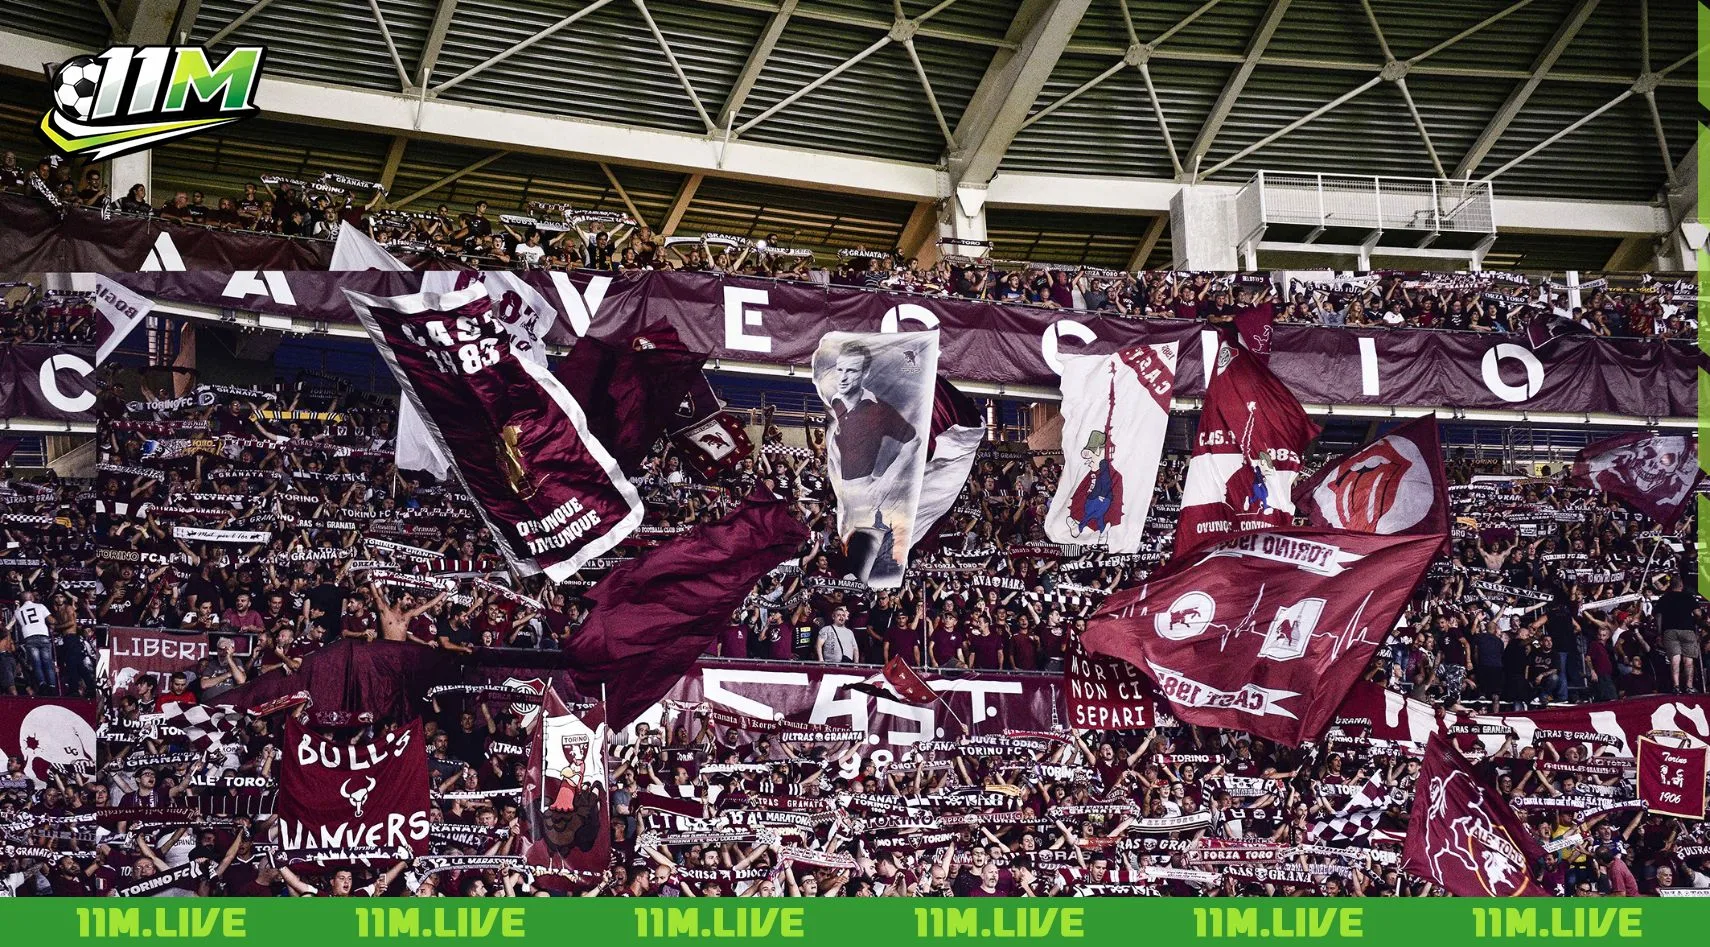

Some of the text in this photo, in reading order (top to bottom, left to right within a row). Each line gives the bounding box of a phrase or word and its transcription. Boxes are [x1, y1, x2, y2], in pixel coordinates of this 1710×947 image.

[311, 182, 345, 194] TORINO
[850, 249, 883, 260] GRANATA
[146, 398, 179, 411] TORINO
[280, 493, 319, 504] TORINO
[341, 508, 376, 518] TORINO
[326, 520, 356, 530] GRANATA
[96, 549, 139, 562] TORINO
[292, 546, 337, 560] GRANATA
[20, 608, 39, 625] 12
[112, 637, 207, 661] LIBERI
[1071, 678, 1142, 701] NON CI
[1076, 704, 1145, 731] SEPARI
[563, 735, 588, 743] TORINO
[783, 731, 862, 742] ULTRAS GRANATA
[298, 730, 411, 771] BULL'S
[959, 746, 1022, 757] TORINO FC
[126, 754, 199, 768] GRANATA
[1170, 754, 1208, 764] TORINO
[1661, 752, 1688, 765] Torino
[188, 773, 266, 787] ALE' TORO
[787, 799, 824, 809] GRANATA
[1659, 791, 1682, 804] 1906
[279, 811, 430, 852] WANVERS
[433, 856, 450, 869] 12
[1203, 850, 1274, 862] FORZA TORO
[120, 867, 190, 896] TORINO FC
